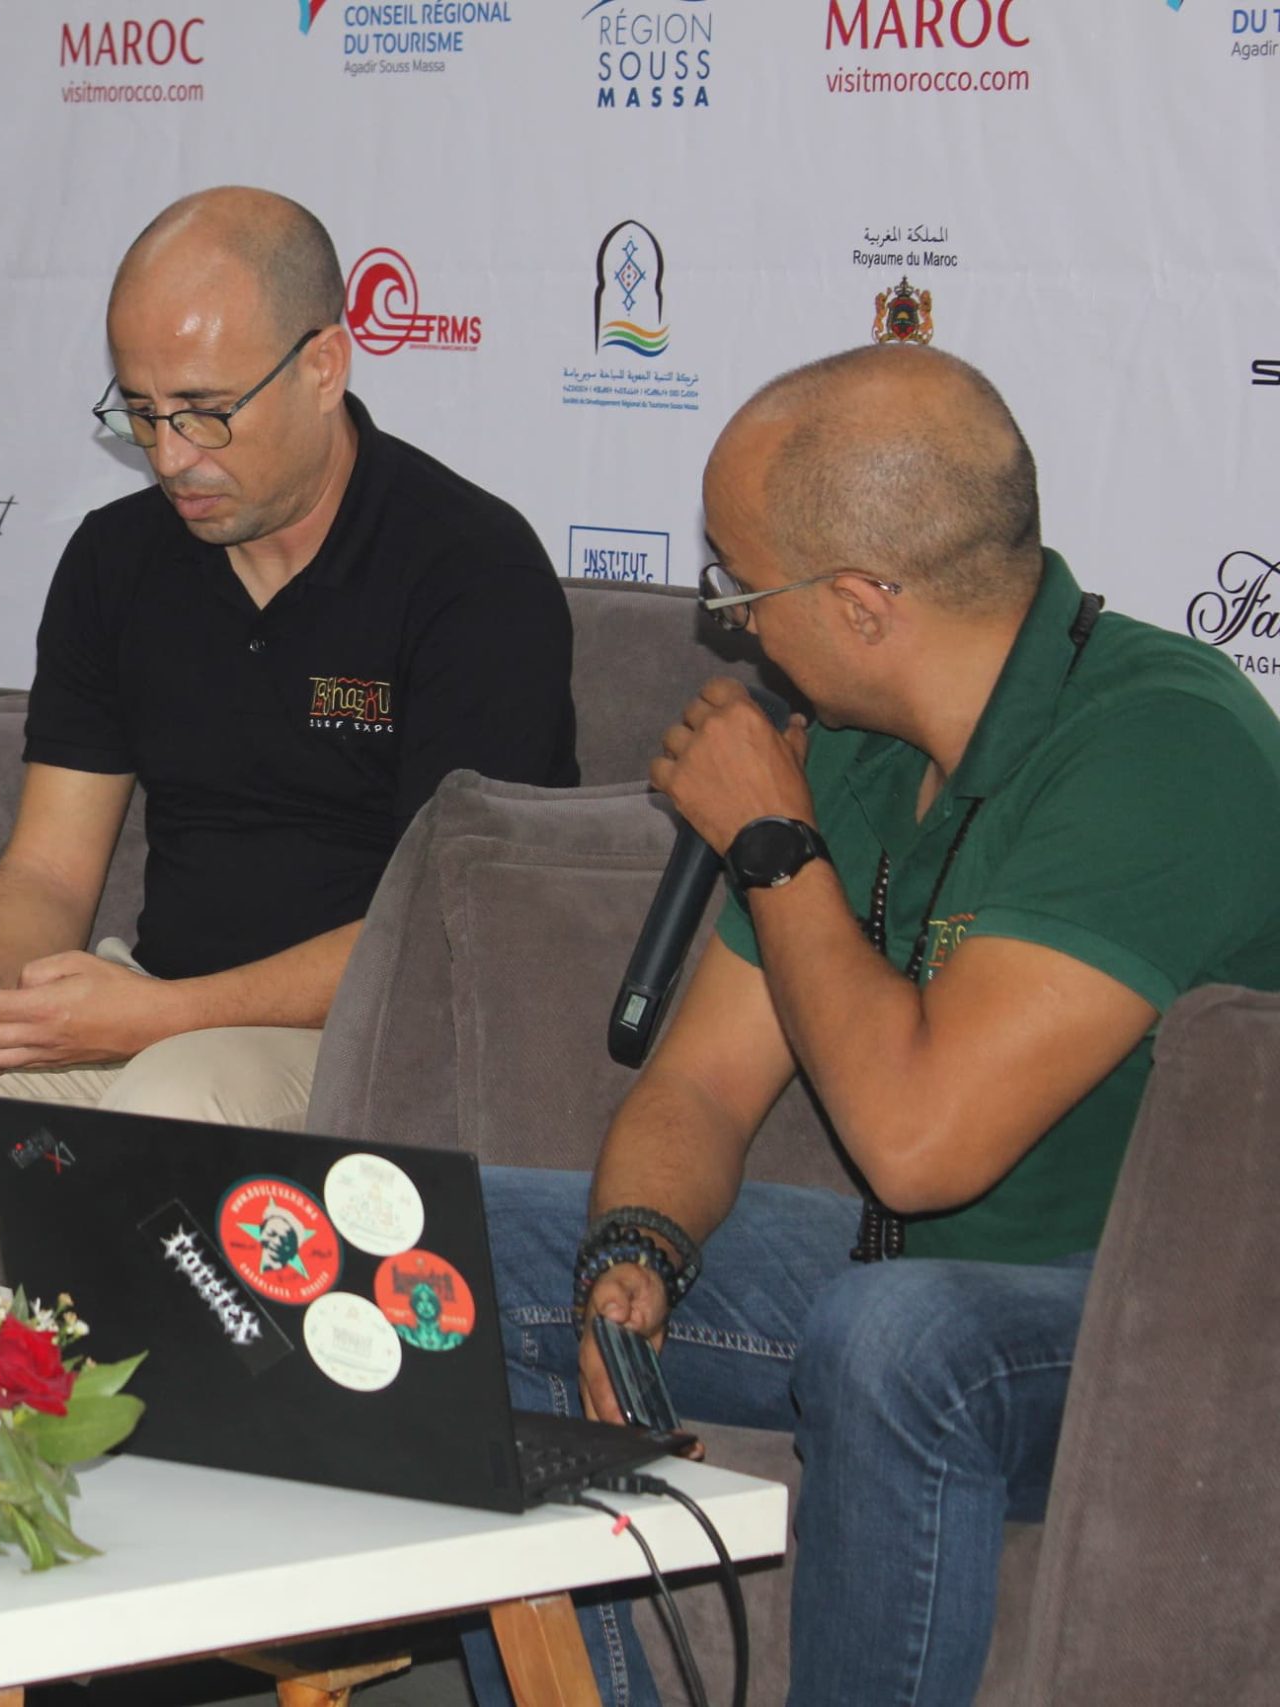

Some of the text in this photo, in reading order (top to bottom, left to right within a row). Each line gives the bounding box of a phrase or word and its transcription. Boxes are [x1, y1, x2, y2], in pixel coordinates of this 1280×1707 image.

[344, 0, 511, 27] CONSEIL RÉGIONAL
[825, 0, 1031, 50] MAROC
[1232, 8, 1267, 34] DU
[60, 17, 205, 67] MAROC
[599, 12, 713, 46] RÉGION
[344, 31, 464, 54] DU TOURISME
[1230, 39, 1280, 60] Agadir
[344, 59, 446, 76] Agadir Souss Massa
[598, 49, 712, 82] SOUSS
[61, 80, 205, 104] visitmorocco.com
[826, 66, 1031, 93] visitmorocco.com
[597, 85, 710, 109] MASSA
[863, 224, 948, 248] المملكة المغربية
[853, 249, 958, 269] Royaume du Maroc
[424, 314, 482, 345] FRMS
[583, 548, 648, 576] INSTITUT
